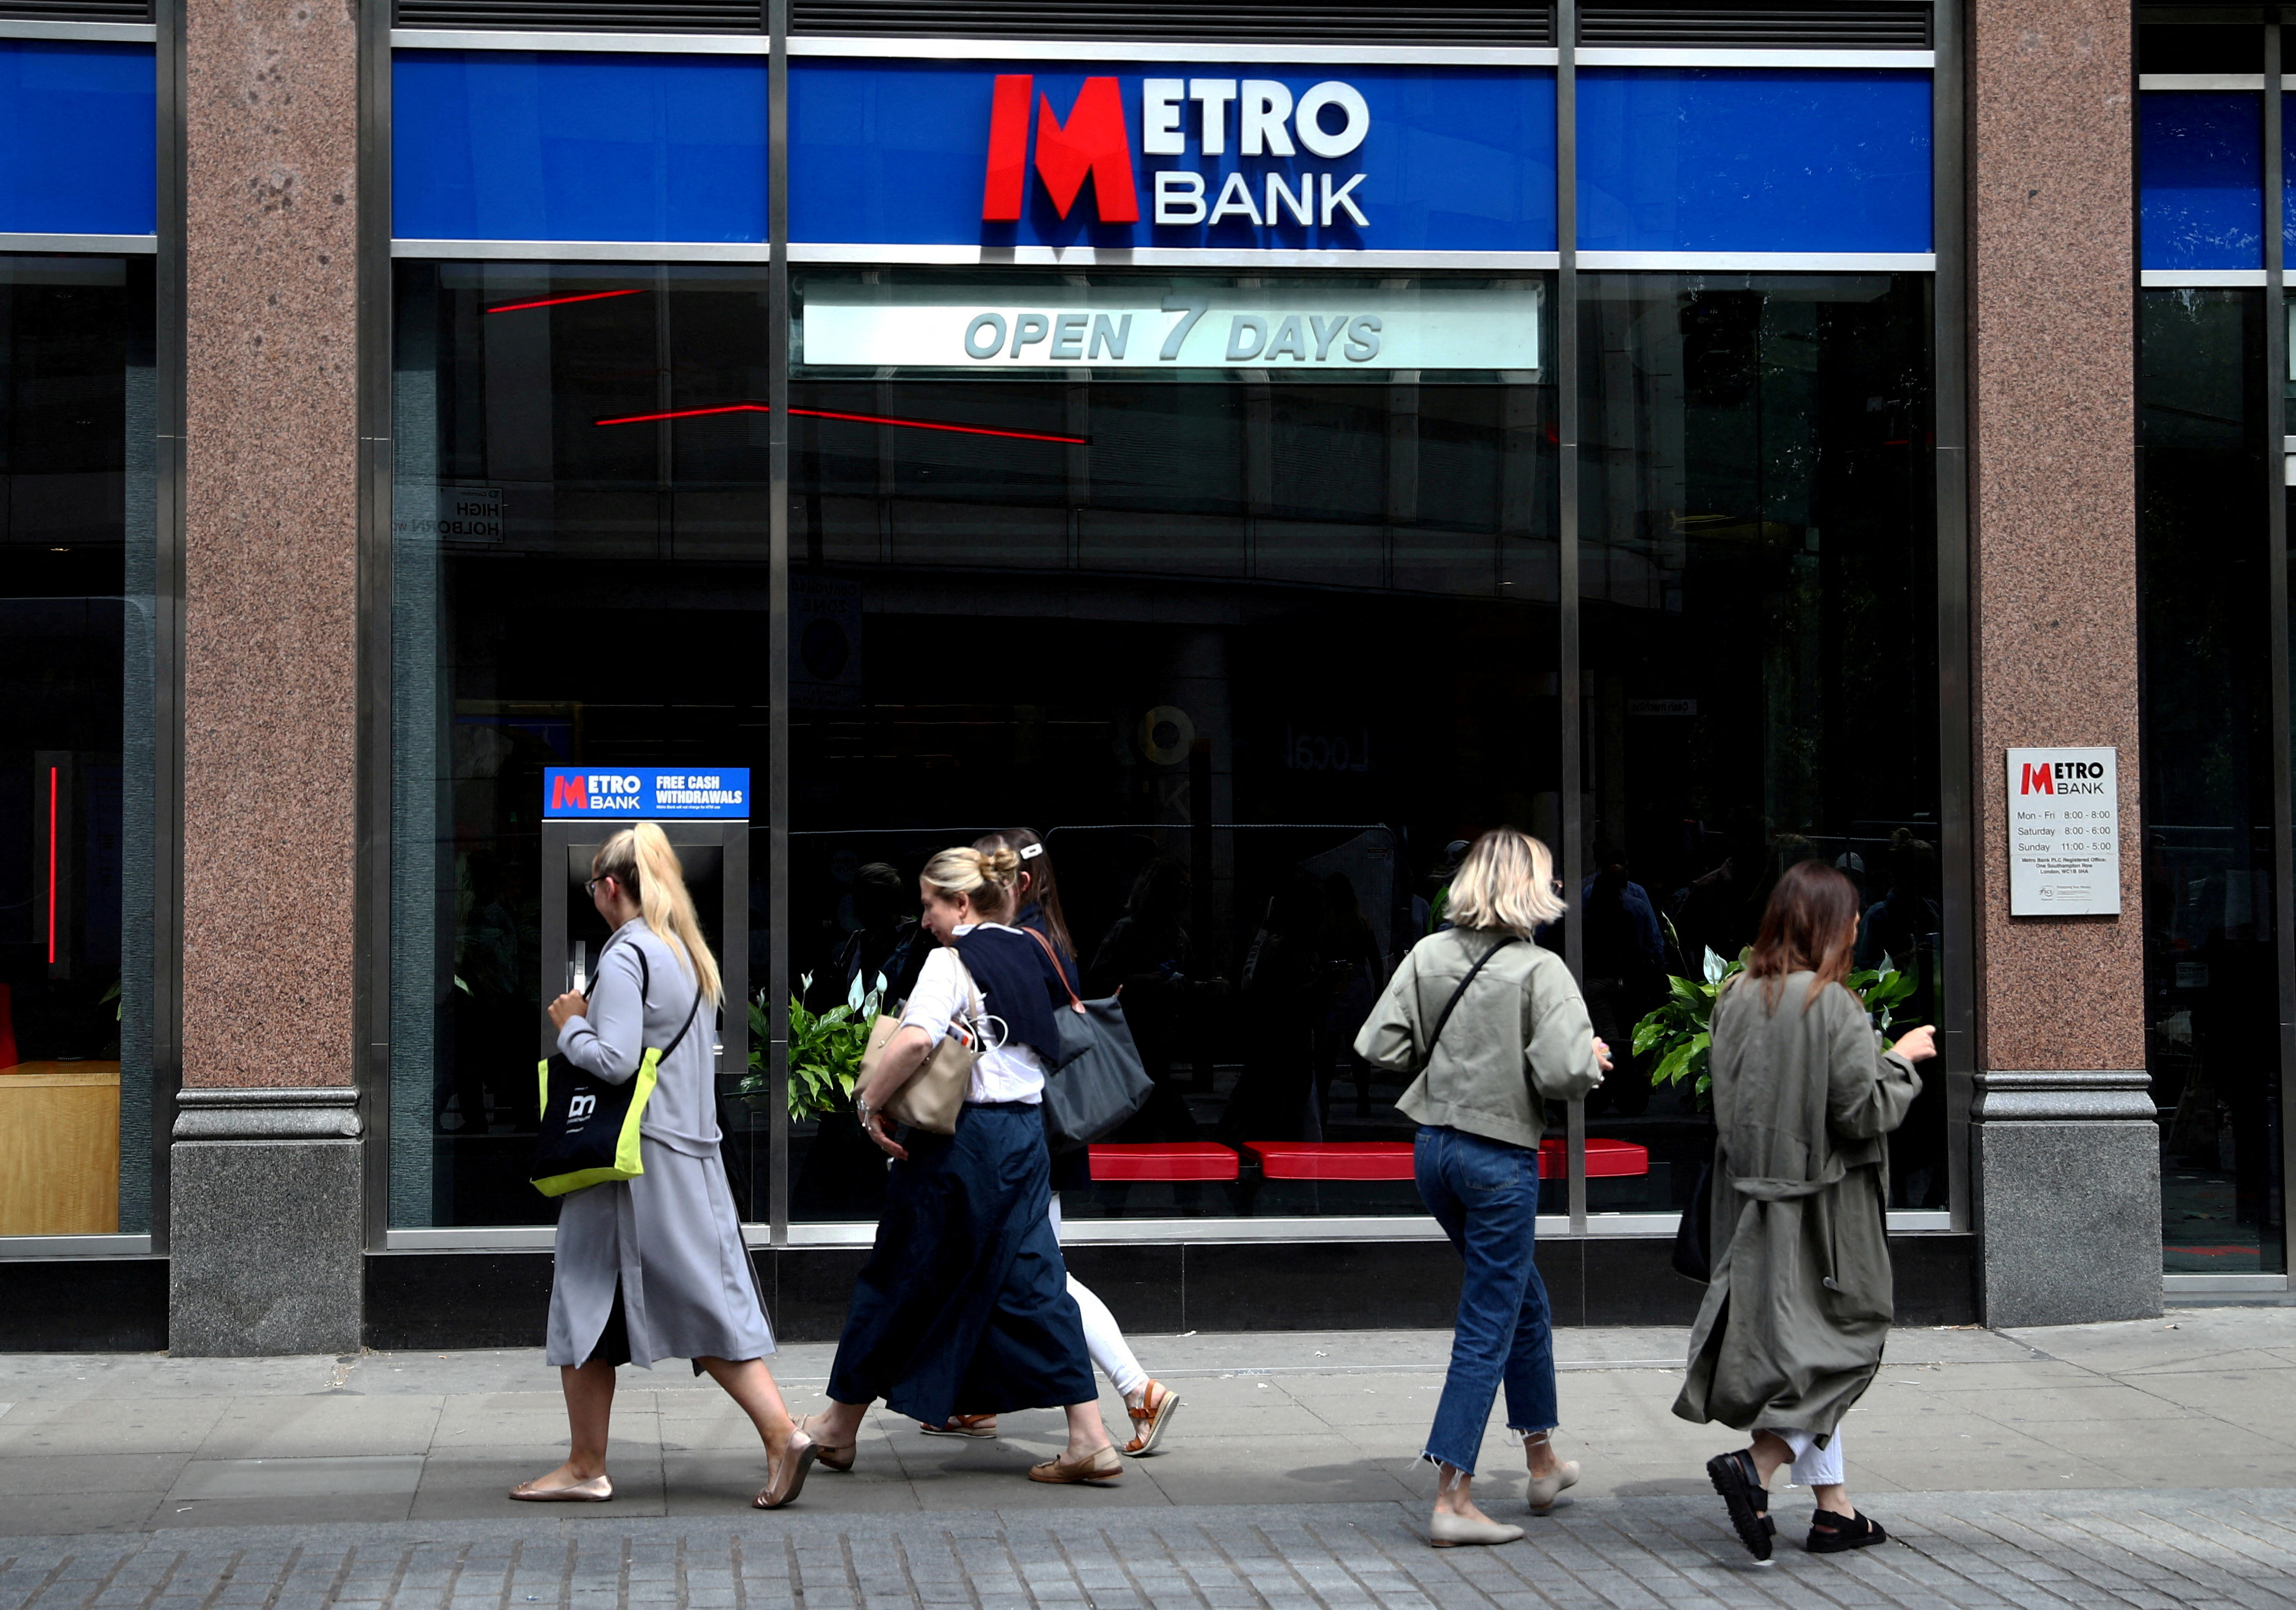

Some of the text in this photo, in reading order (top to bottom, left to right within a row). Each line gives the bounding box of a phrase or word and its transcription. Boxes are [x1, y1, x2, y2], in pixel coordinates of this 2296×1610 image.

[981, 74, 1370, 222] METRO
[1154, 171, 1371, 227] BANK
[964, 295, 1383, 362] OPEN 7 DAYS
[656, 776, 720, 789] FREE CASH
[2020, 762, 2104, 795] METRO
[551, 775, 641, 809] METRO
[2057, 782, 2104, 795] BANK
[590, 796, 641, 809] BANK
[656, 790, 743, 804] WITHDRAWALS
[2018, 827, 2055, 836] Saturday
[2018, 843, 2050, 852] Sunday
